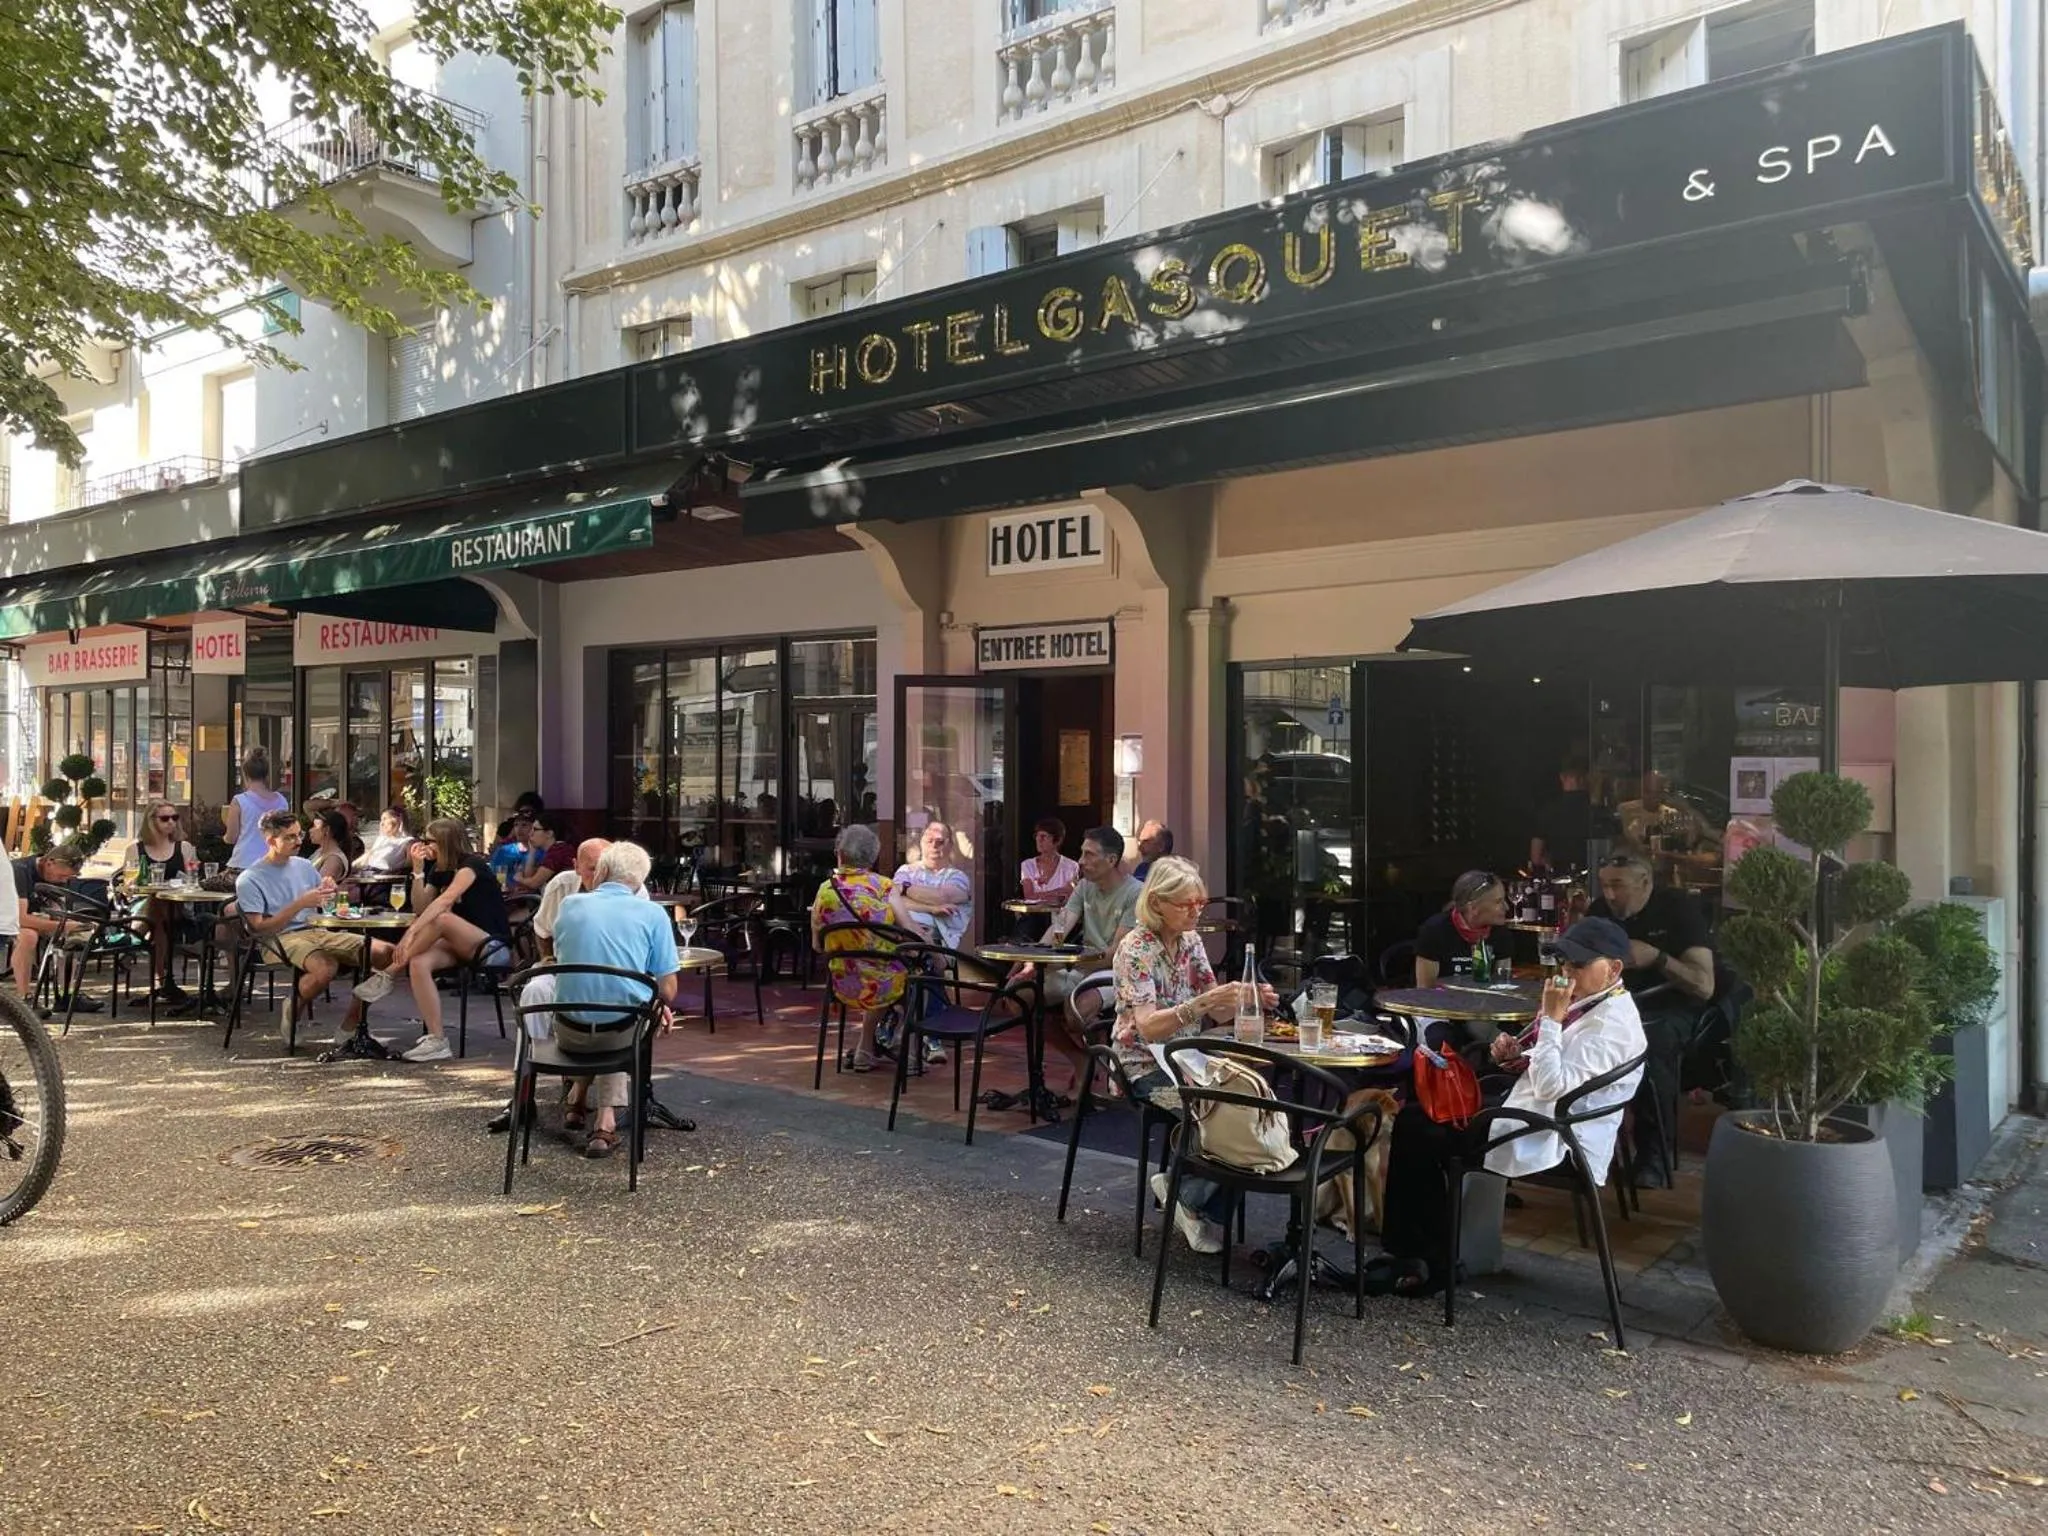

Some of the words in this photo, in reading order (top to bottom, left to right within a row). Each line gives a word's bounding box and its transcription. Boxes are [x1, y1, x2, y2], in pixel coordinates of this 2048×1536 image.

[810, 303, 1030, 395] HOTEL
[1682, 168, 1715, 202] &
[1756, 123, 1897, 184] SPA
[452, 520, 575, 568] RESTAURANT
[991, 515, 1101, 566] HOTEL
[48, 653, 70, 674] BAR
[74, 645, 139, 672] BRASSERIE
[195, 633, 241, 660] HOTEL
[980, 634, 1046, 662] ENTREE
[1050, 630, 1108, 659] HOTEL
